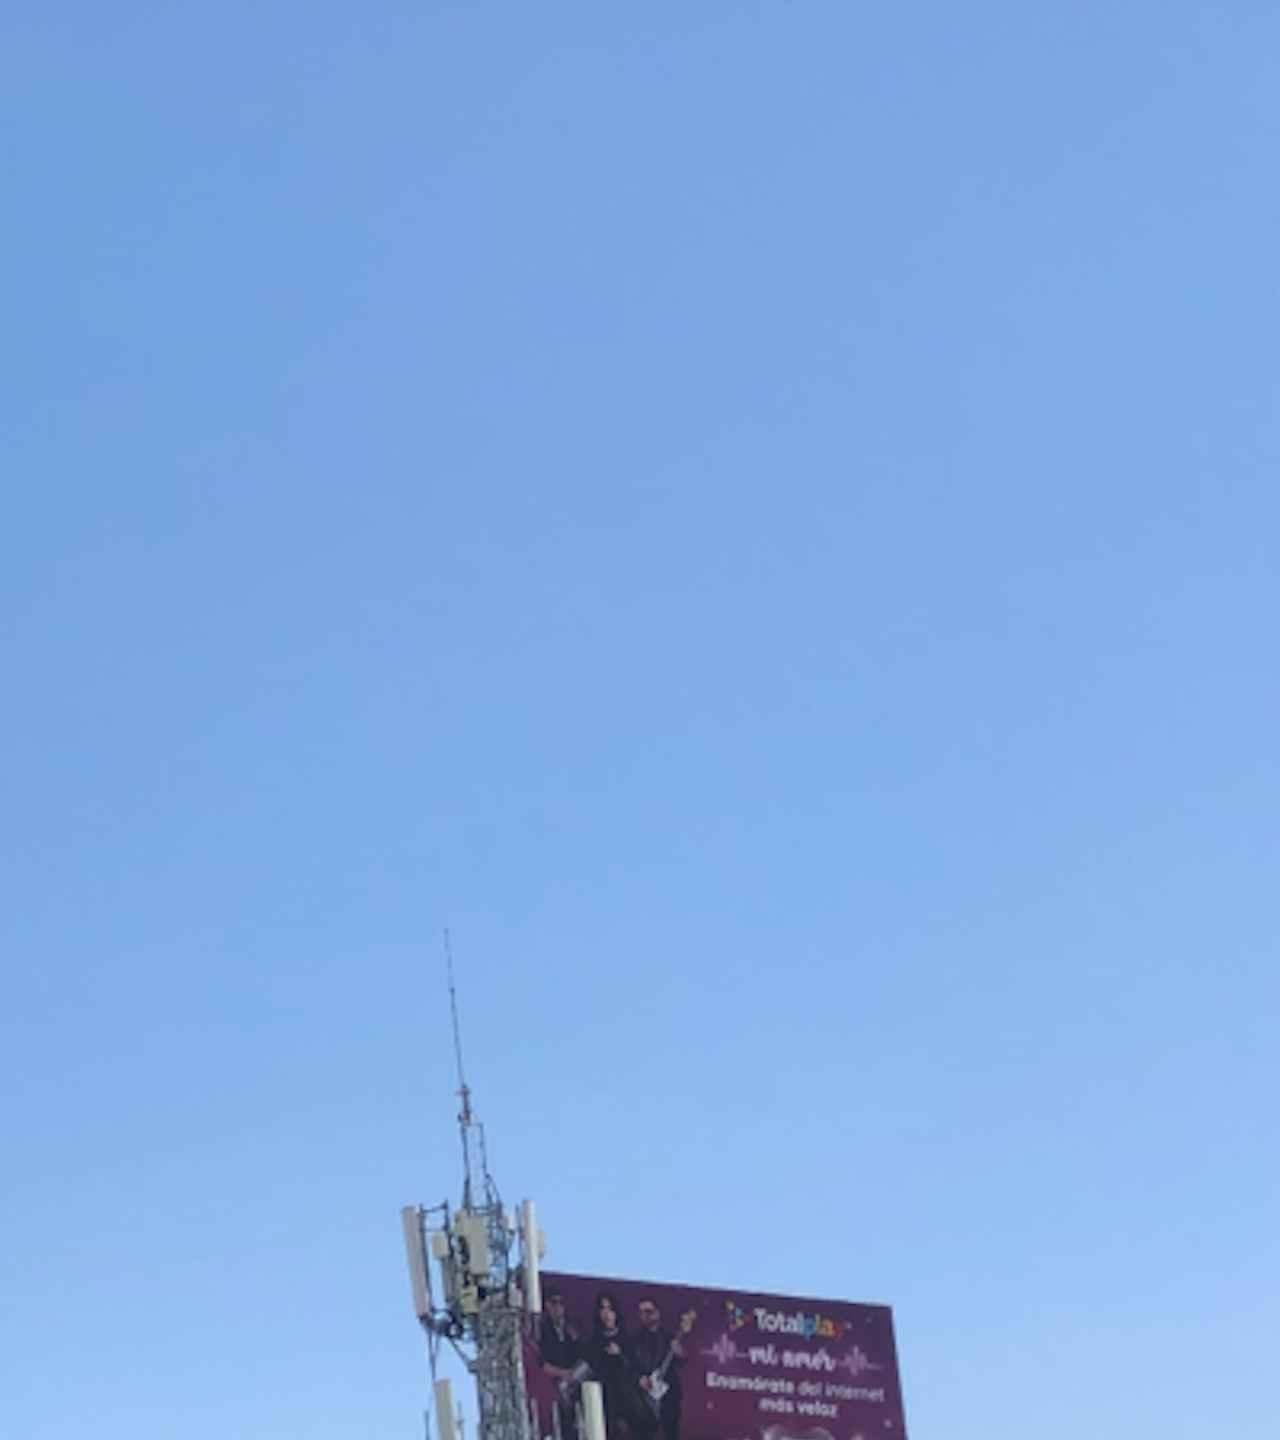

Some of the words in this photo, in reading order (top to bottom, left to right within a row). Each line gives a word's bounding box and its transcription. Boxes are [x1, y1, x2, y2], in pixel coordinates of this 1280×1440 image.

[753, 1308, 845, 1341] Totalplay
[797, 1379, 822, 1397] del
[826, 1382, 885, 1402] internet
[796, 1400, 838, 1418] veloz
